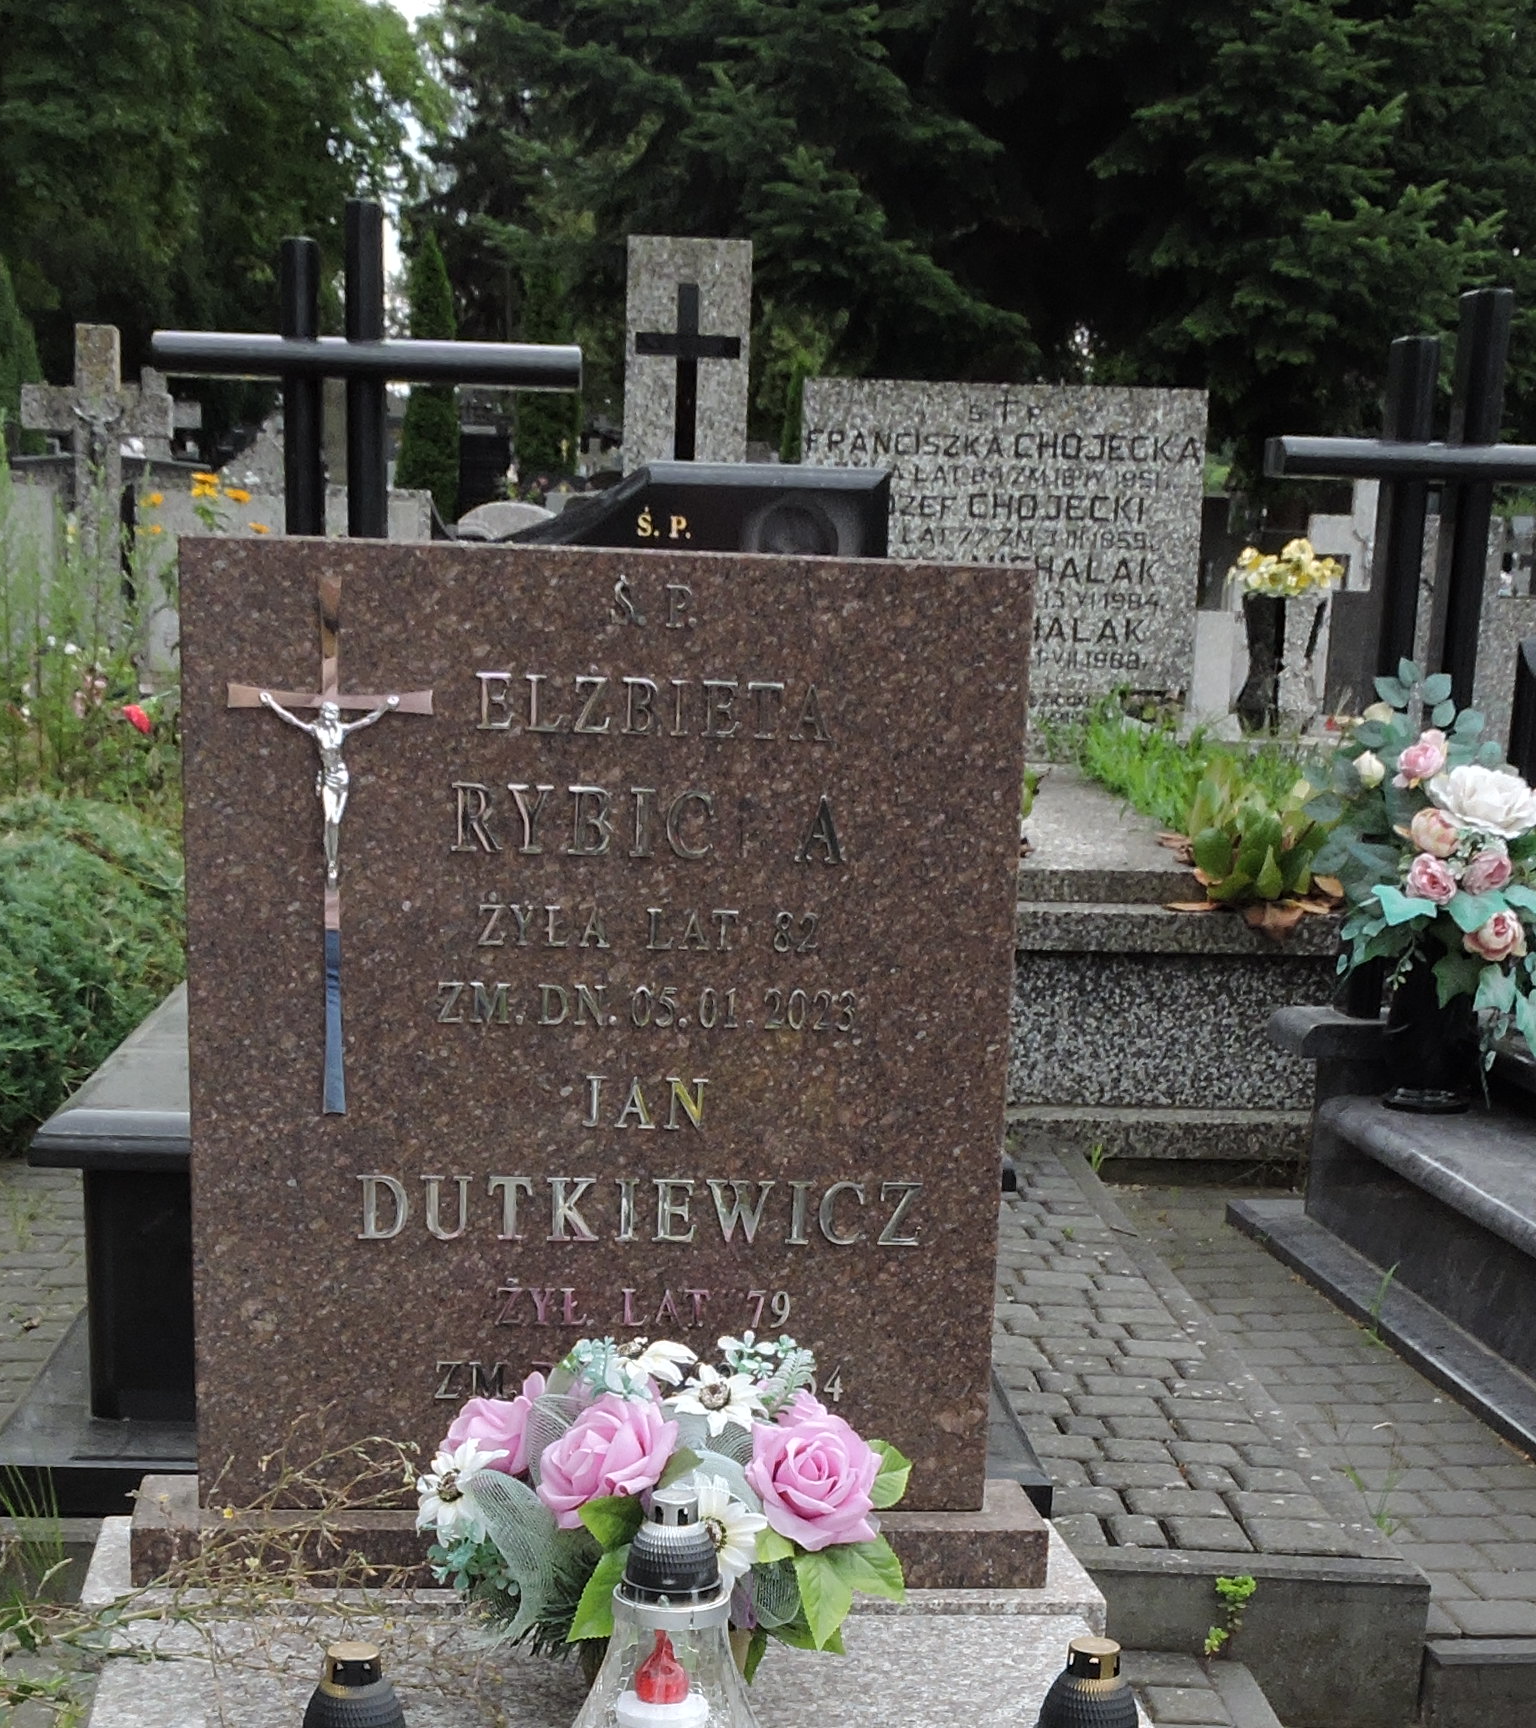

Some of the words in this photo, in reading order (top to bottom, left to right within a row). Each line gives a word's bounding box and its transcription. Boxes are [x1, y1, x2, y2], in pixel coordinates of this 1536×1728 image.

[805, 427, 1005, 460] FRANCISZKA
[1014, 430, 1202, 466] CHOJECKA
[636, 505, 660, 538] Ś.
[668, 514, 692, 540] P.
[969, 492, 1145, 524] CHOJECKI
[975, 554, 1157, 586] HALAK
[475, 663, 835, 742] ELŻBIETA
[450, 782, 847, 865] RYBICA
[645, 906, 740, 952] LAT
[773, 910, 820, 954] 82
[582, 1075, 709, 1131] JAN
[357, 1173, 924, 1247] DUTKIEWICZ
[495, 1278, 588, 1328] ŻYŁ
[621, 1287, 711, 1332] LAT
[746, 1289, 792, 1331] 79
